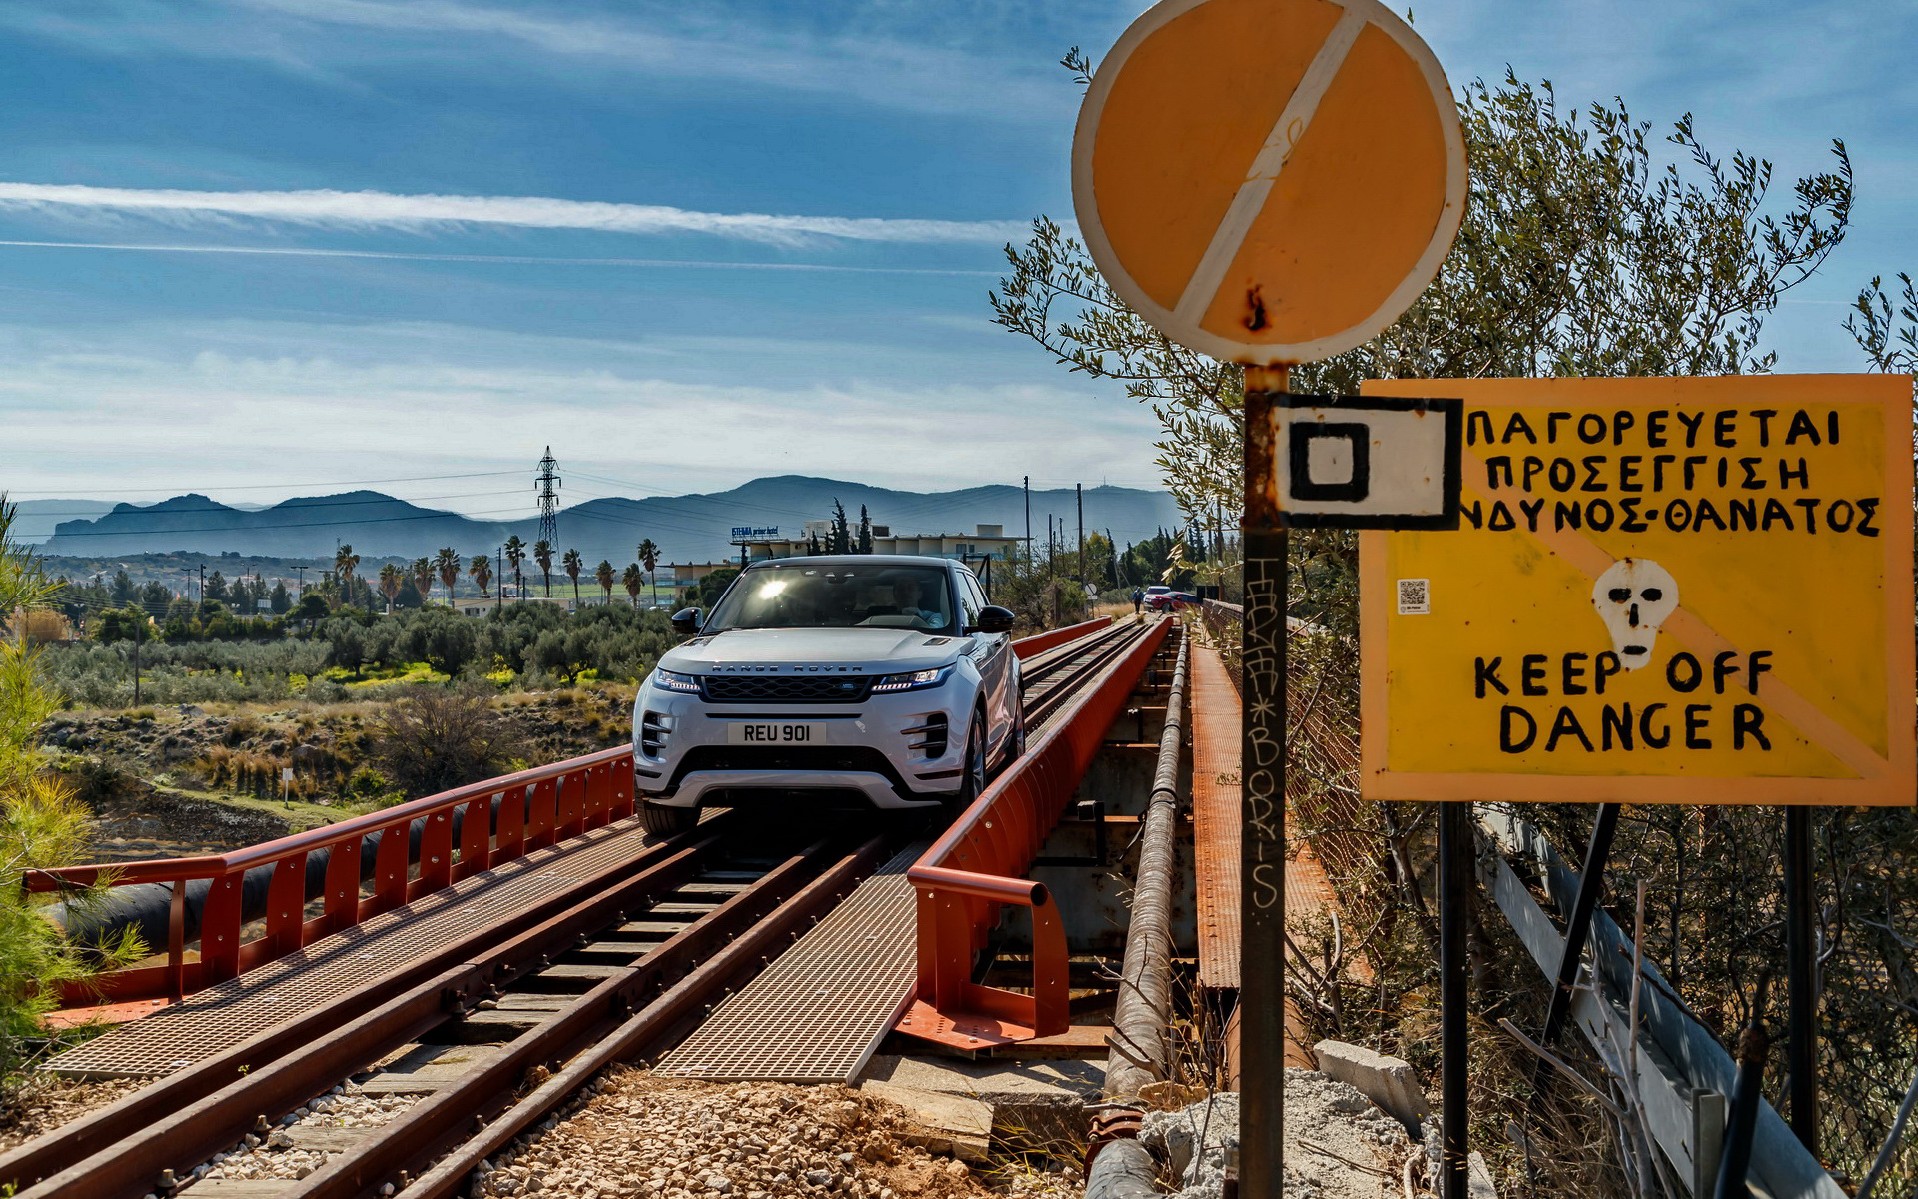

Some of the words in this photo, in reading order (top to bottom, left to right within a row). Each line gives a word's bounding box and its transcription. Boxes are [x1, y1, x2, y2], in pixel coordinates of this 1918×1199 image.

[1466, 408, 1840, 448] ΠΑΓΟΡΕΥΕΤΑΙ
[1485, 455, 1809, 493] ΠΡΟΣΕΓΓΙΣΗ
[1475, 650, 1620, 699] KEEP
[1666, 650, 1773, 696] OFF
[744, 724, 776, 742] REU
[783, 724, 810, 742] 901
[1499, 702, 1772, 754] DANGER
